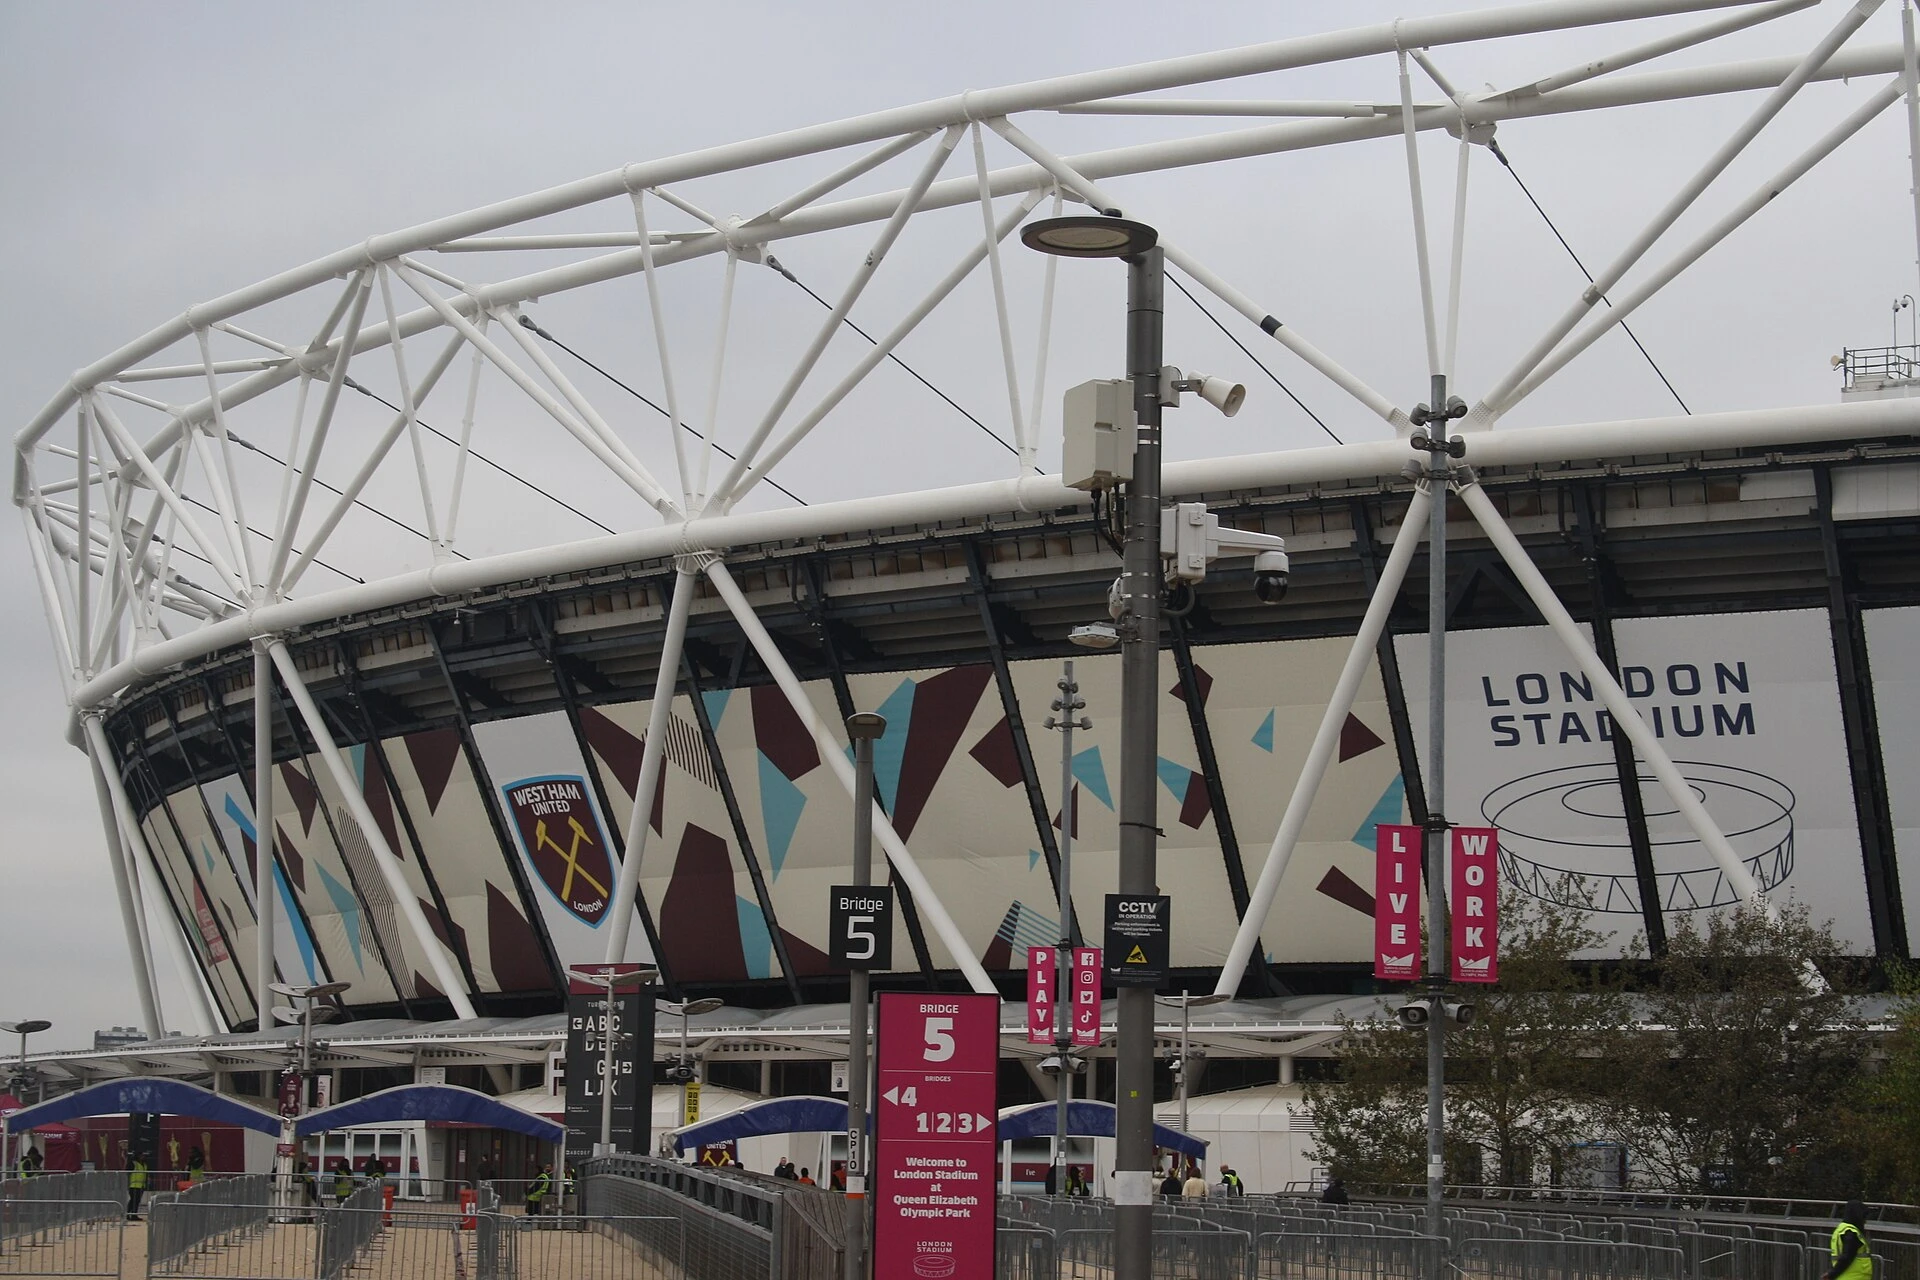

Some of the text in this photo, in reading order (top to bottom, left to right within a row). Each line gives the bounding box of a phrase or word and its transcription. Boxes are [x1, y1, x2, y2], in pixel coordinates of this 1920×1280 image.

[1482, 661, 1751, 707] LONDON
[513, 784, 581, 806] WEST HAM
[532, 800, 570, 816] UNITED
[1388, 832, 1408, 945] LIVE
[1460, 835, 1488, 948] WORK
[574, 899, 604, 913] LONDON
[840, 896, 884, 912] Bridge
[1118, 902, 1157, 913] CCTV
[846, 916, 876, 960] 5
[1036, 952, 1047, 1022] PLAY
[920, 1004, 959, 1014] BRIDGE
[923, 1017, 955, 1062] 5
[901, 1086, 917, 1106] 4
[906, 1157, 967, 1167] Welcome to
[894, 1170, 978, 1180] London Stadium
[930, 1184, 942, 1192] at
[893, 1195, 978, 1205] Queen Elizabeth
[900, 1208, 970, 1218] Olympic Park
